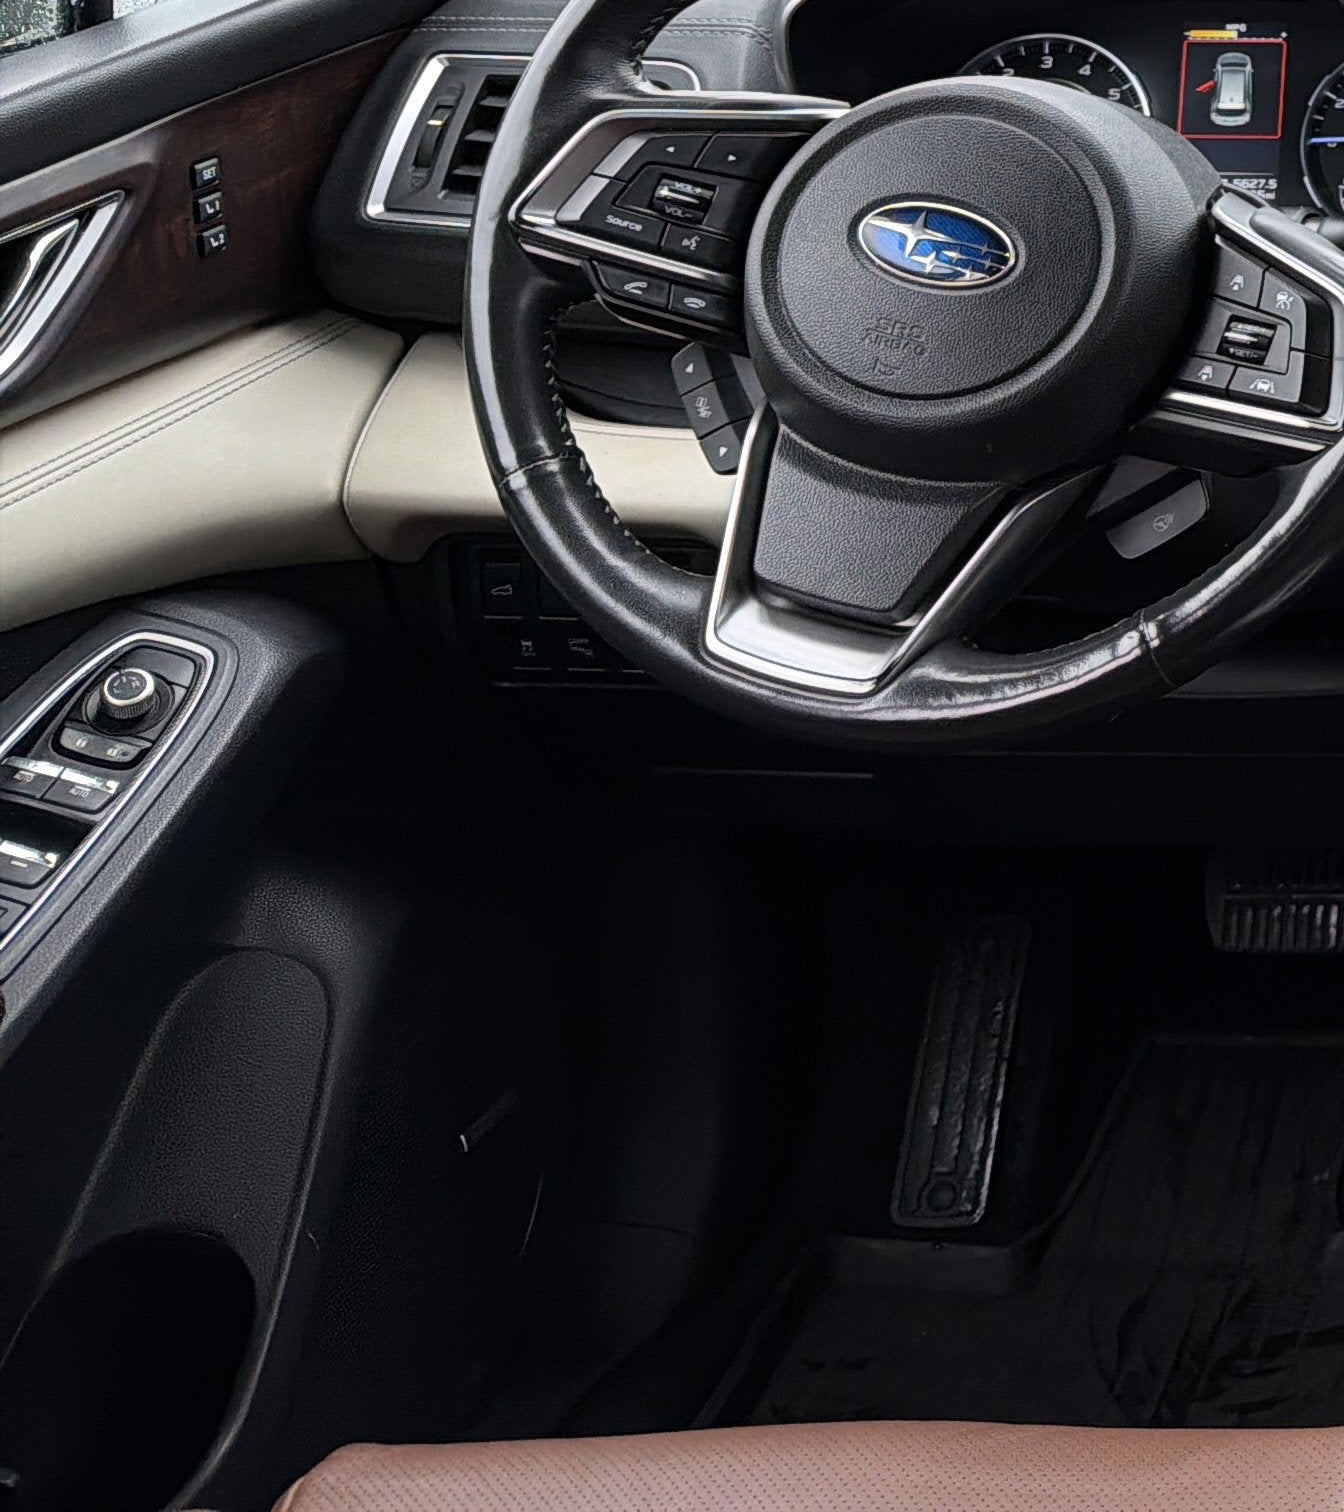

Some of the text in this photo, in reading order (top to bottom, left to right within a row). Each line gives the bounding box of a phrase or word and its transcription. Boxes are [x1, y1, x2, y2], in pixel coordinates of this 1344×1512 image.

[1225, 23, 1247, 33] MPG
[1040, 55, 1053, 68] 3
[1078, 64, 1091, 76] 4
[1108, 88, 1121, 101] 5
[202, 166, 216, 180] SET
[604, 214, 643, 232] Source
